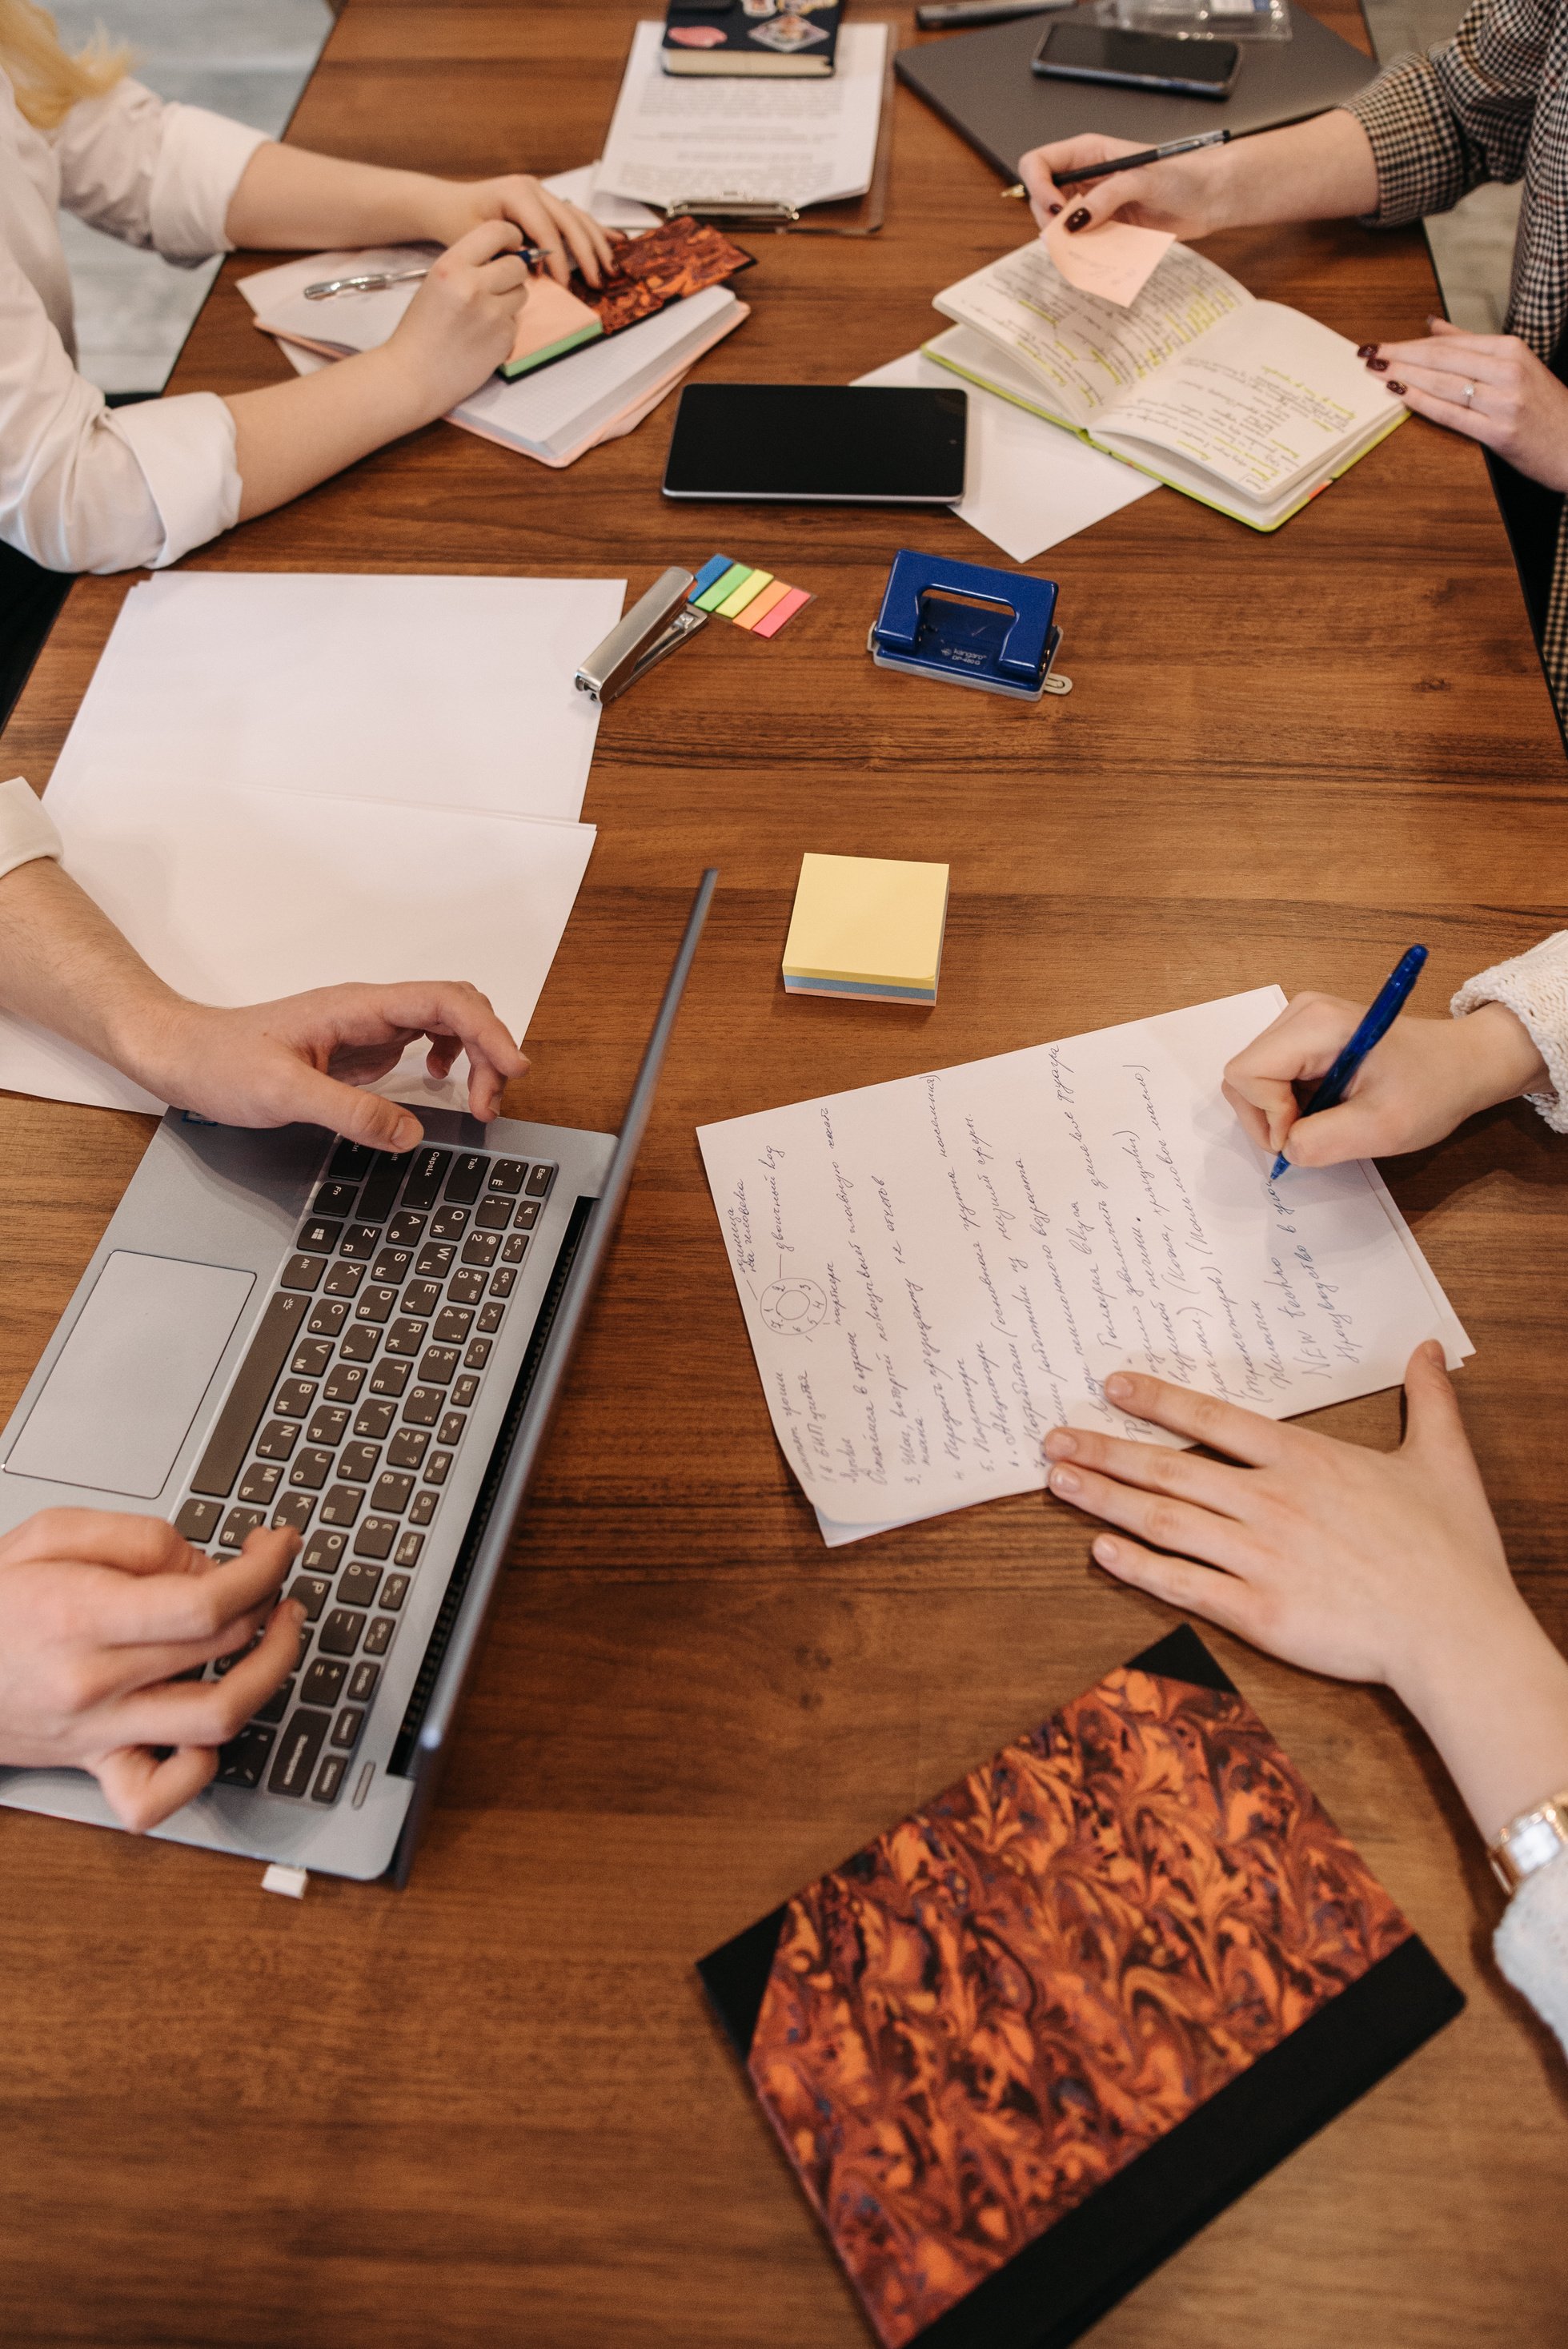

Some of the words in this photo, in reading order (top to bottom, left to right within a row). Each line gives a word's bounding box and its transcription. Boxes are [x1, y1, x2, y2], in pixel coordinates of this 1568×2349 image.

[391, 1151, 399, 1161] ift
[758, 1145, 785, 1170] код
[424, 1151, 440, 1176] CapsLk
[467, 1158, 478, 1170] Tab
[536, 1168, 546, 1179] Esc
[332, 1186, 342, 1195] Fn
[451, 1211, 464, 1221] Q
[732, 1179, 752, 1245] человека
[764, 1176, 795, 1256] двоичный
[408, 1216, 421, 1225] A
[362, 1228, 375, 1238] Z
[471, 1234, 483, 1242] 2
[394, 1252, 407, 1262] S
[437, 1247, 451, 1260] W
[892, 1240, 906, 1264] 12
[300, 1258, 310, 1269] Alt
[1008, 1256, 1029, 1274] из
[347, 1265, 360, 1275] X
[458, 1271, 469, 1279] 3
[423, 1283, 437, 1294] E
[379, 1290, 392, 1300] D
[331, 1304, 344, 1315] C
[443, 1309, 454, 1317] 4
[408, 1323, 422, 1333] R
[365, 1329, 377, 1339] F
[315, 1344, 329, 1354] V
[428, 1349, 440, 1357] 5
[1292, 1329, 1333, 1379] NEW
[394, 1364, 407, 1374] T
[347, 1369, 360, 1381] G
[299, 1383, 313, 1394] B
[413, 1389, 425, 1398] 6
[378, 1405, 391, 1415] Y
[1049, 1383, 1069, 1429] аши
[331, 1410, 345, 1422] H
[280, 1425, 295, 1437] N
[399, 1432, 411, 1441] 7
[315, 1452, 327, 1463] J
[361, 1446, 375, 1459] U
[263, 1468, 278, 1482] M
[382, 1474, 395, 1484] 8
[296, 1496, 311, 1509] K
[194, 1503, 206, 1516] Alt
[365, 1520, 379, 1529] 9
[327, 1535, 342, 1549] O
[348, 1564, 362, 1576] 0
[312, 1581, 325, 1594] P
